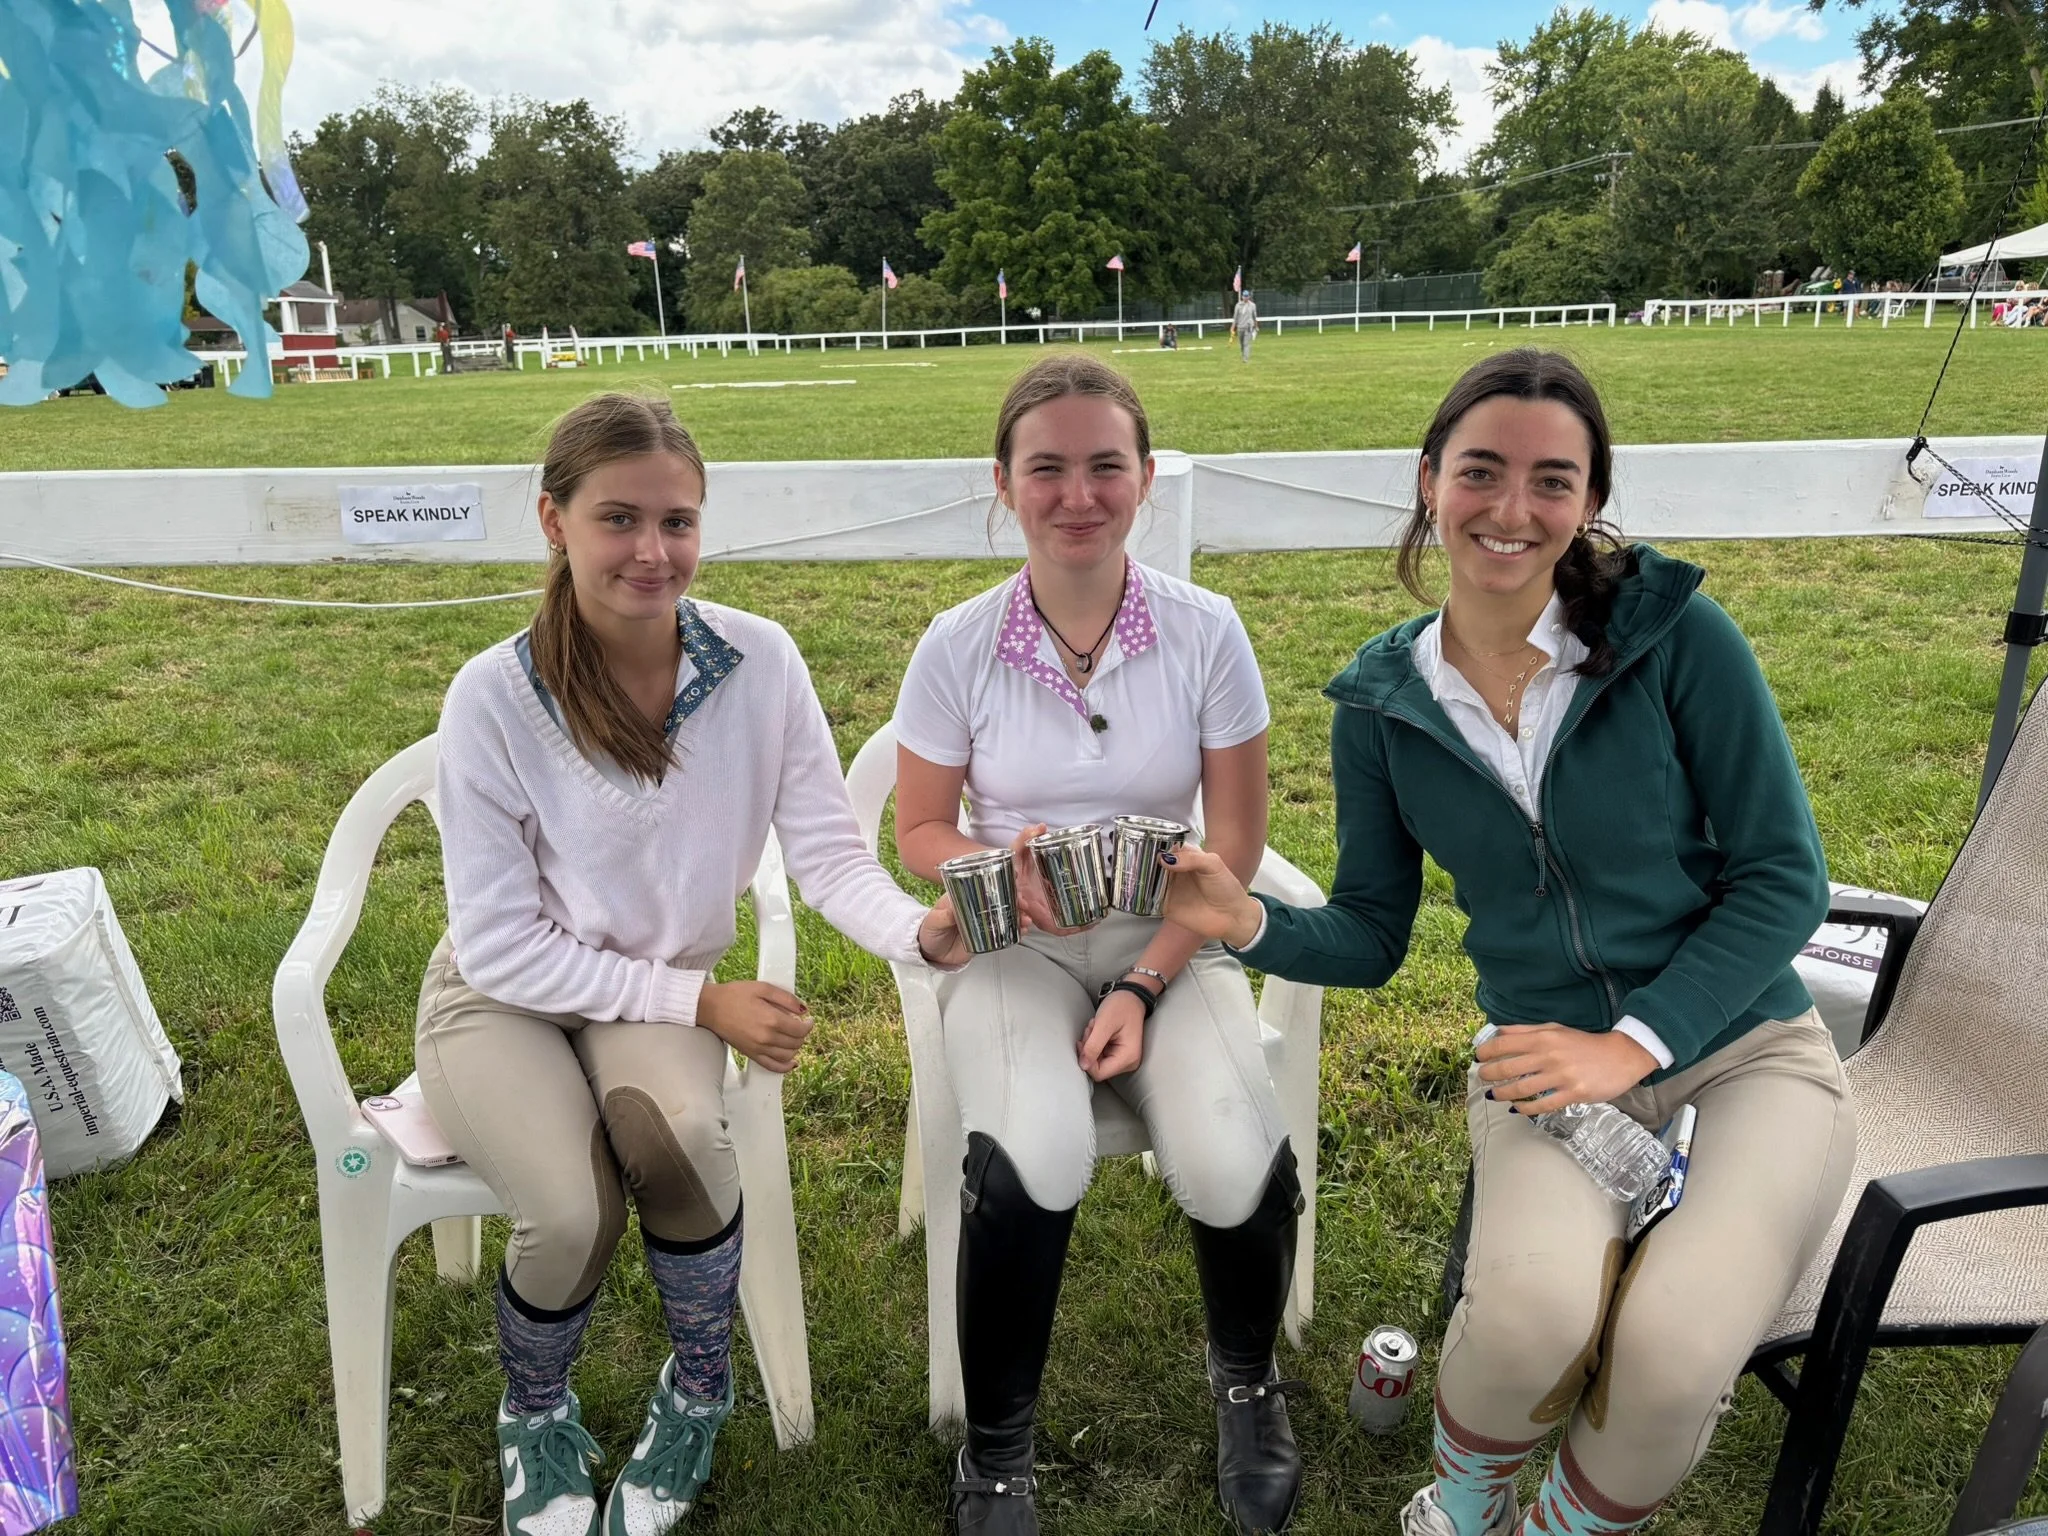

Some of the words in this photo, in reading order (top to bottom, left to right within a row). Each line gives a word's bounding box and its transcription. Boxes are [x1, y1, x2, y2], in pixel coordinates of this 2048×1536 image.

[1938, 482, 1995, 497] SPEAK
[1999, 481, 2038, 495] KIND
[353, 508, 409, 523] SPEAK
[412, 506, 470, 521] KINDLY
[1811, 946, 1874, 969] HORSE
[24, 1041, 48, 1076] Made
[33, 1005, 100, 1138] imperial-equestrian.com
[40, 1075, 64, 1113] U.S.A.
[1358, 1352, 1414, 1399] Co
[529, 1414, 546, 1425] NIKE
